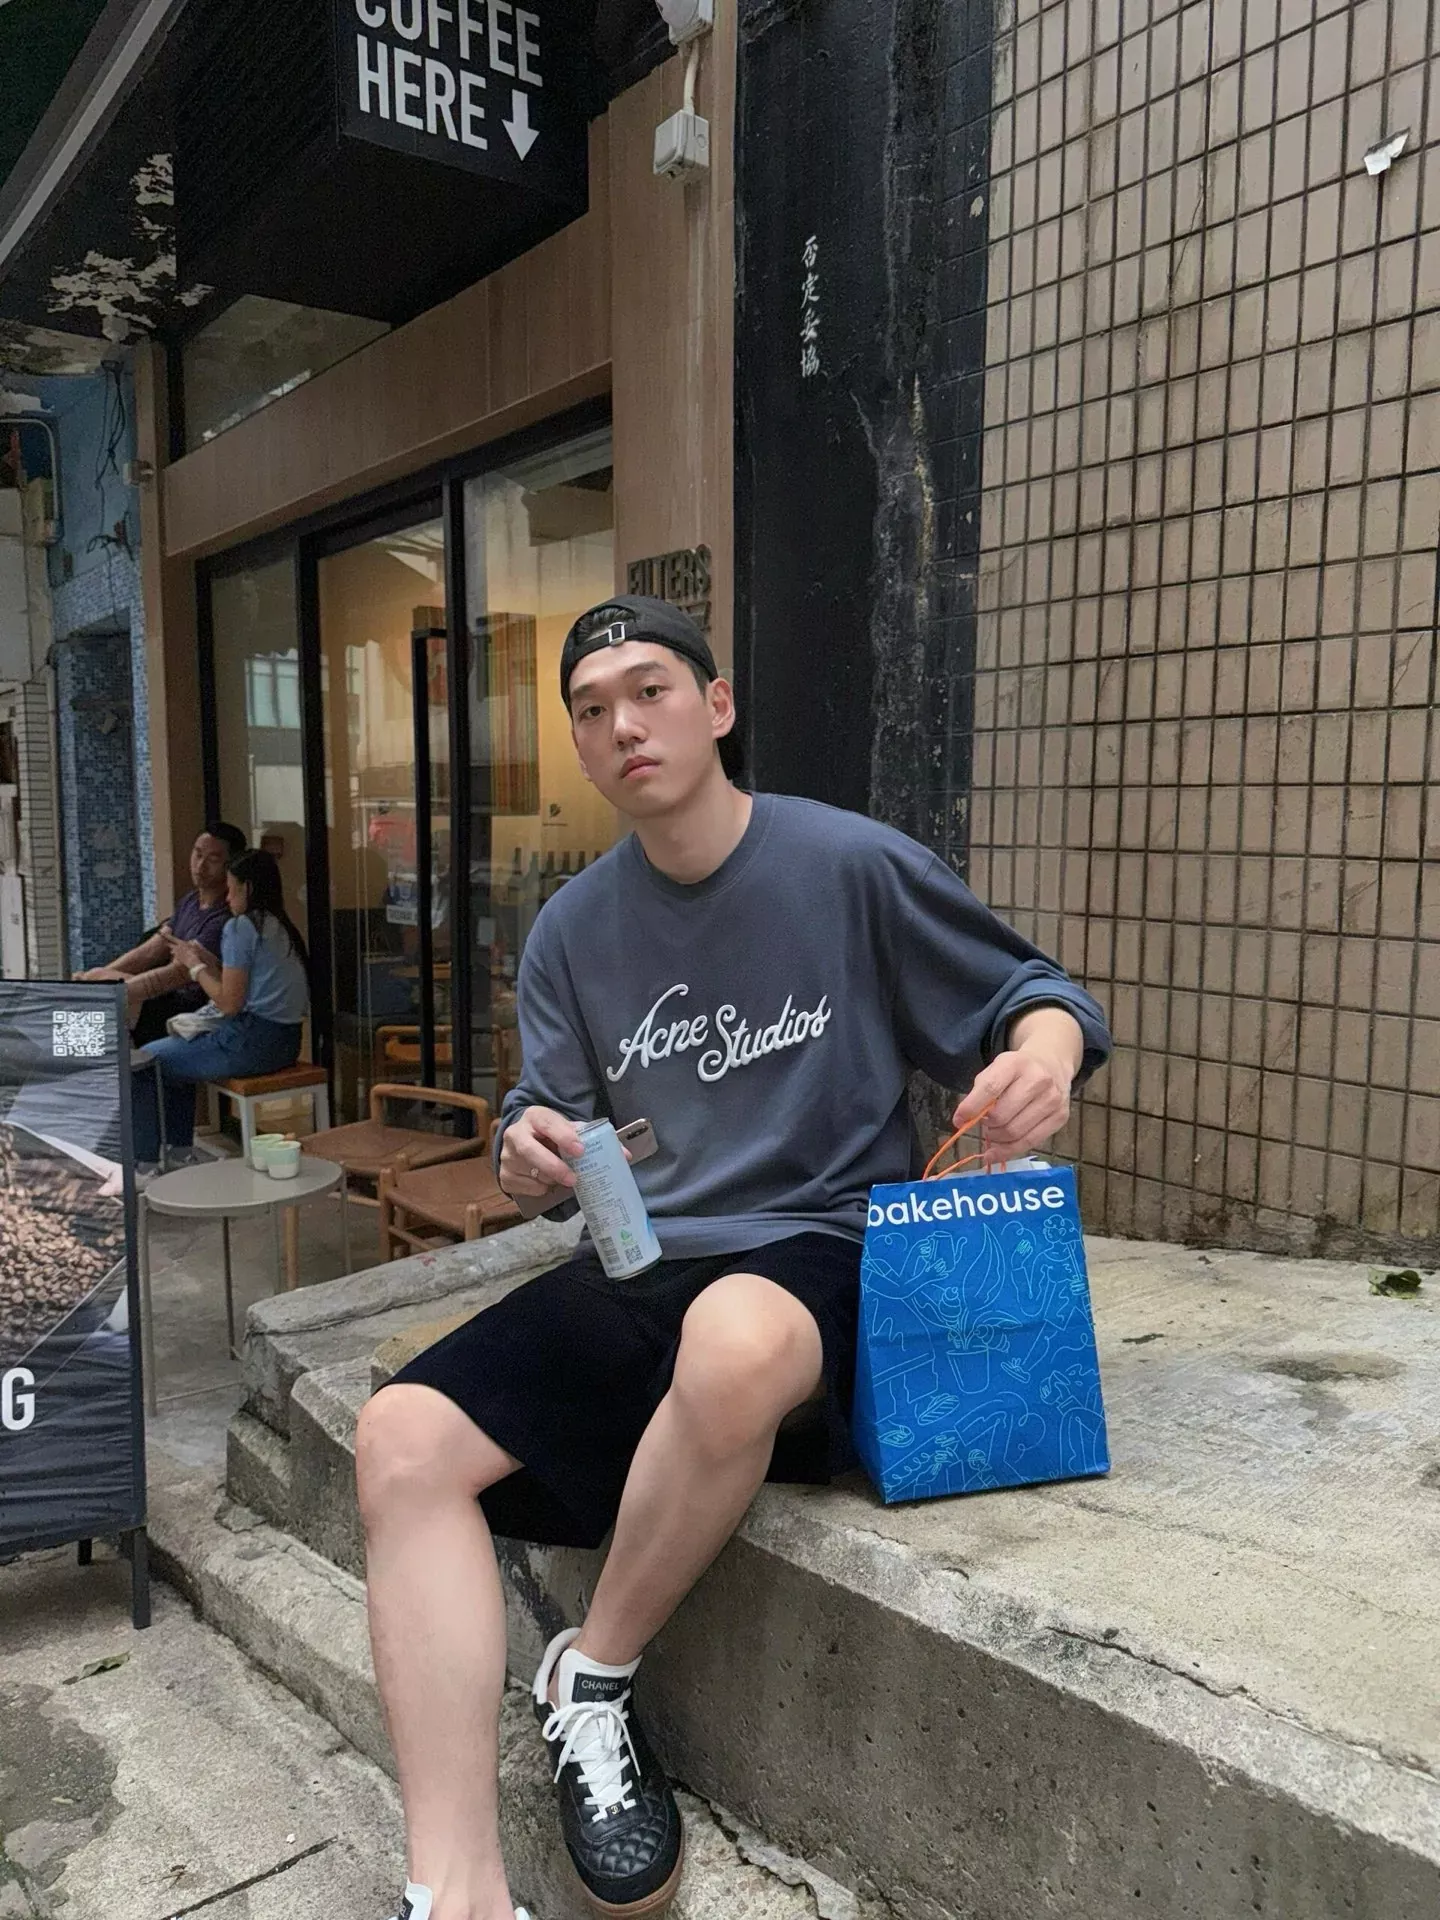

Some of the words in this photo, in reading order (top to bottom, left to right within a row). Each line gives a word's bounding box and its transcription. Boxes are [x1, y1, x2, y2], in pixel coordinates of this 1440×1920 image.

[357, 33, 488, 150] HERE
[606, 983, 709, 1082] Acne
[697, 994, 832, 1082] Studios
[867, 1185, 1065, 1227] bakehouse
[581, 1679, 620, 1691] CHANEL
